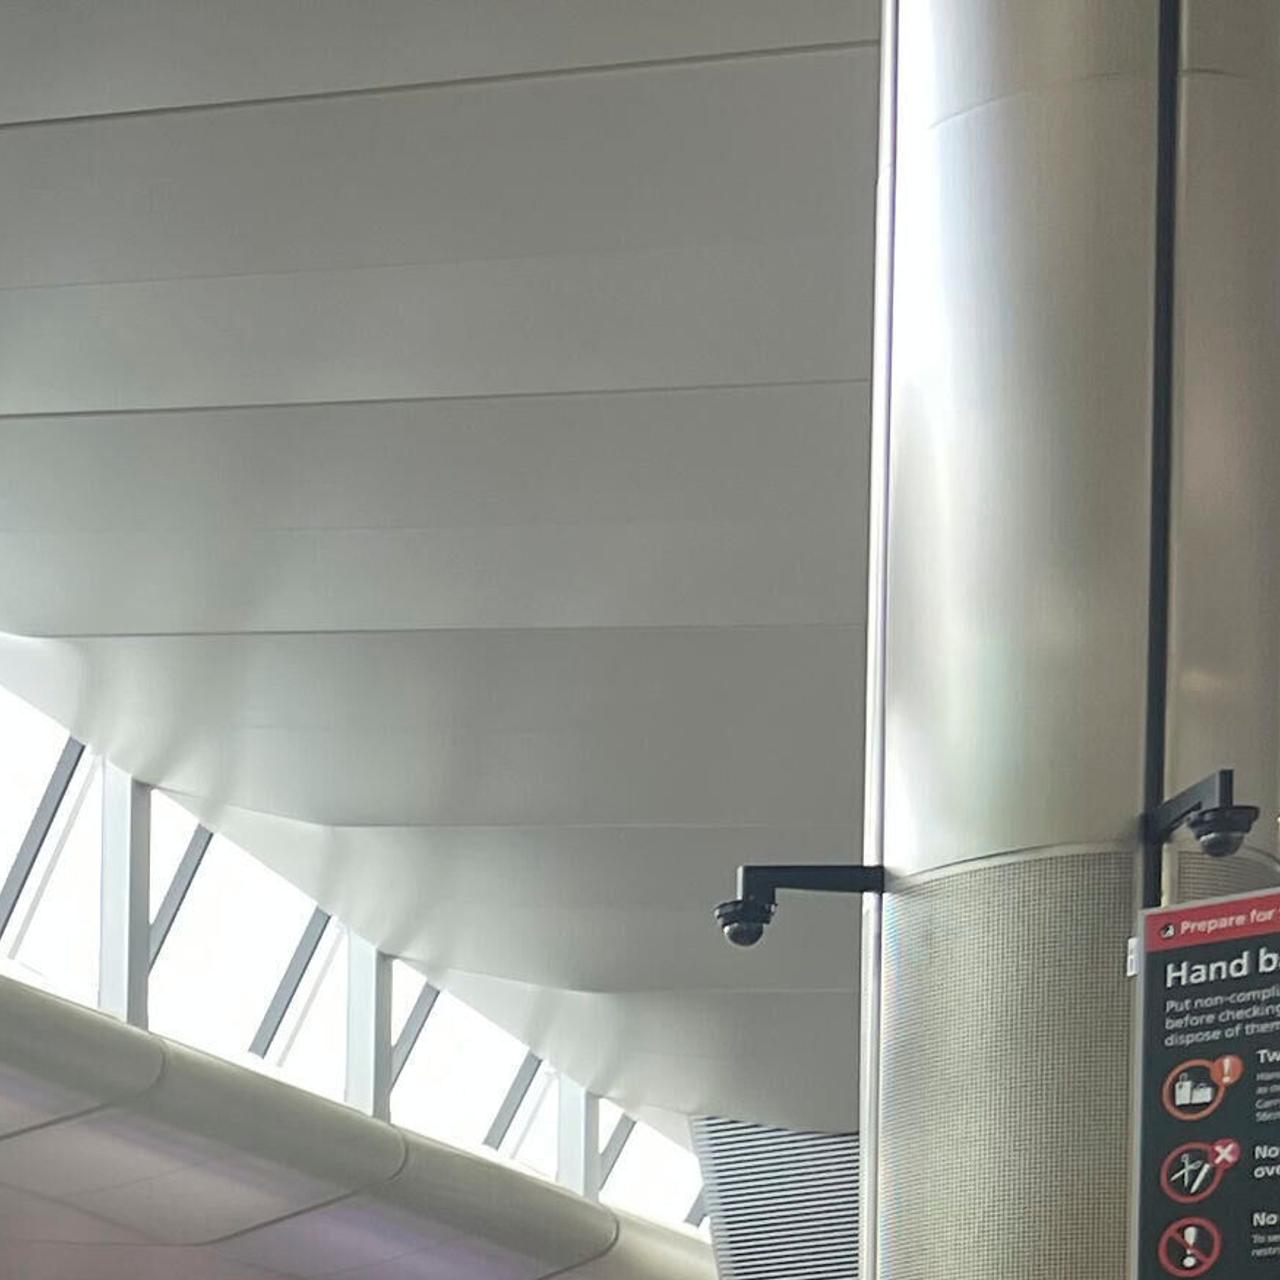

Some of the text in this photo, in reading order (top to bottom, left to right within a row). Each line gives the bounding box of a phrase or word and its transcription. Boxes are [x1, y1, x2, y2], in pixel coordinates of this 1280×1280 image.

[1181, 909, 1275, 934] Prepare for
[1166, 947, 1280, 988] Hand b
[1166, 986, 1280, 1013] Put non-compli
[1165, 1014, 1215, 1029] before
[1165, 1028, 1221, 1047] dispose
[1225, 1027, 1241, 1038] of
[1255, 1145, 1279, 1159] No
[1253, 1212, 1278, 1226] No
